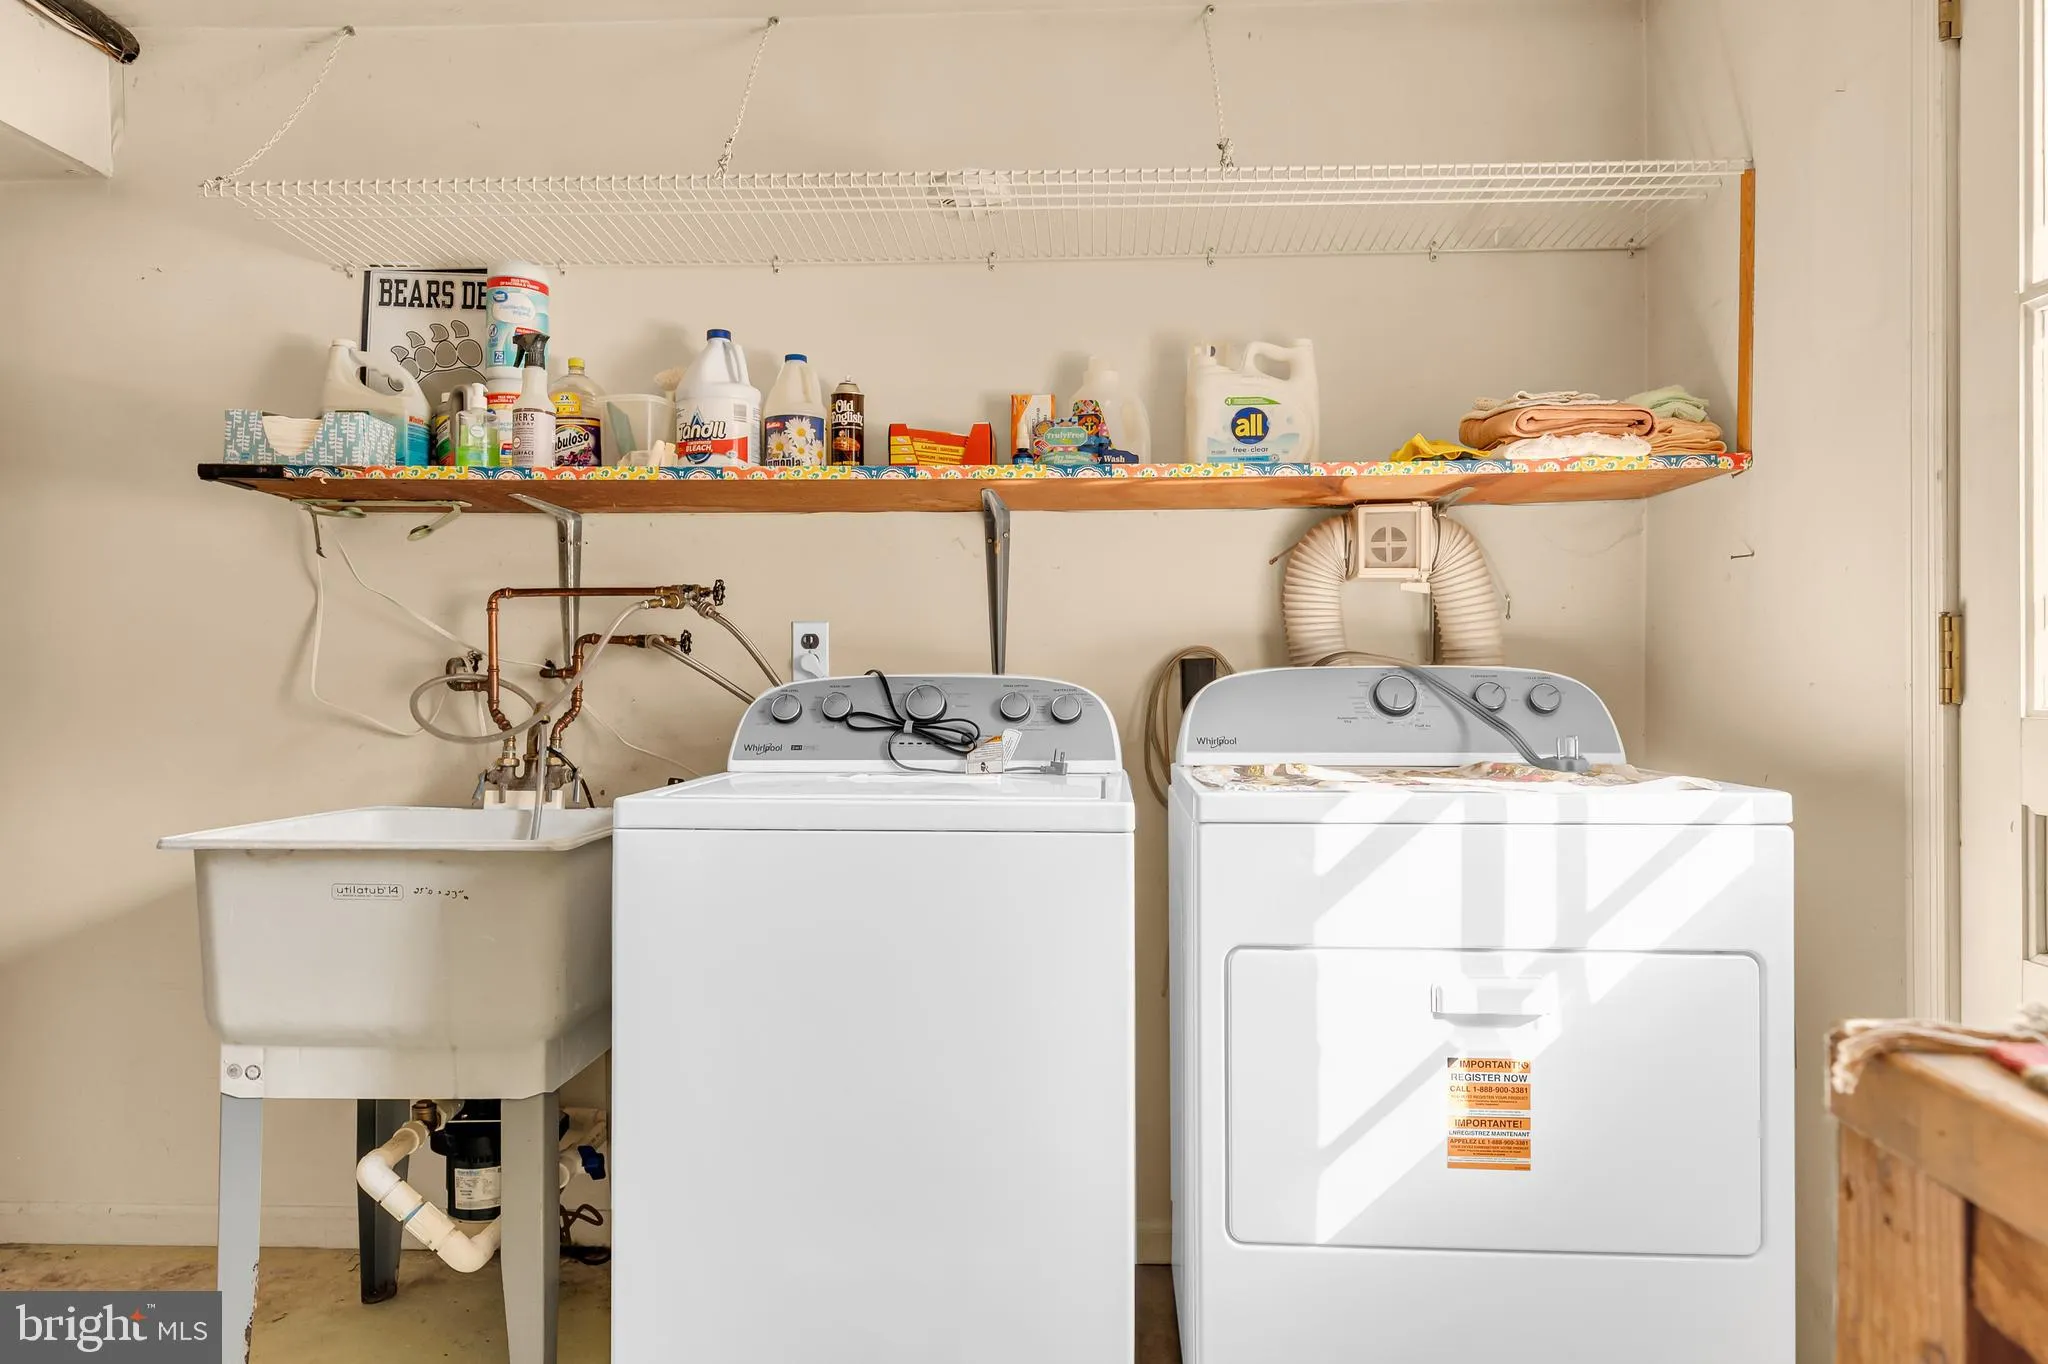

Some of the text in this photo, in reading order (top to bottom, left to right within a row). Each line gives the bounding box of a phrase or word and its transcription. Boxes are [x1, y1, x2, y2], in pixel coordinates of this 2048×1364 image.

[378, 278, 455, 309] BEARS
[495, 351, 504, 359] 75
[835, 399, 854, 412] Old
[832, 410, 864, 426] English
[1235, 413, 1264, 437] all
[554, 432, 590, 451] buloso
[1046, 432, 1085, 441] TrulyFree
[685, 444, 712, 452] BLEACH
[1104, 455, 1126, 463] Wash
[1195, 735, 1237, 749] Whirlpool
[743, 742, 783, 755] Whirlpool
[1450, 1072, 1528, 1083] REGISTER NOW
[1449, 1085, 1529, 1094] CALL 1-888-900-3381
[1454, 1119, 1523, 1129] IMPORTANTE!
